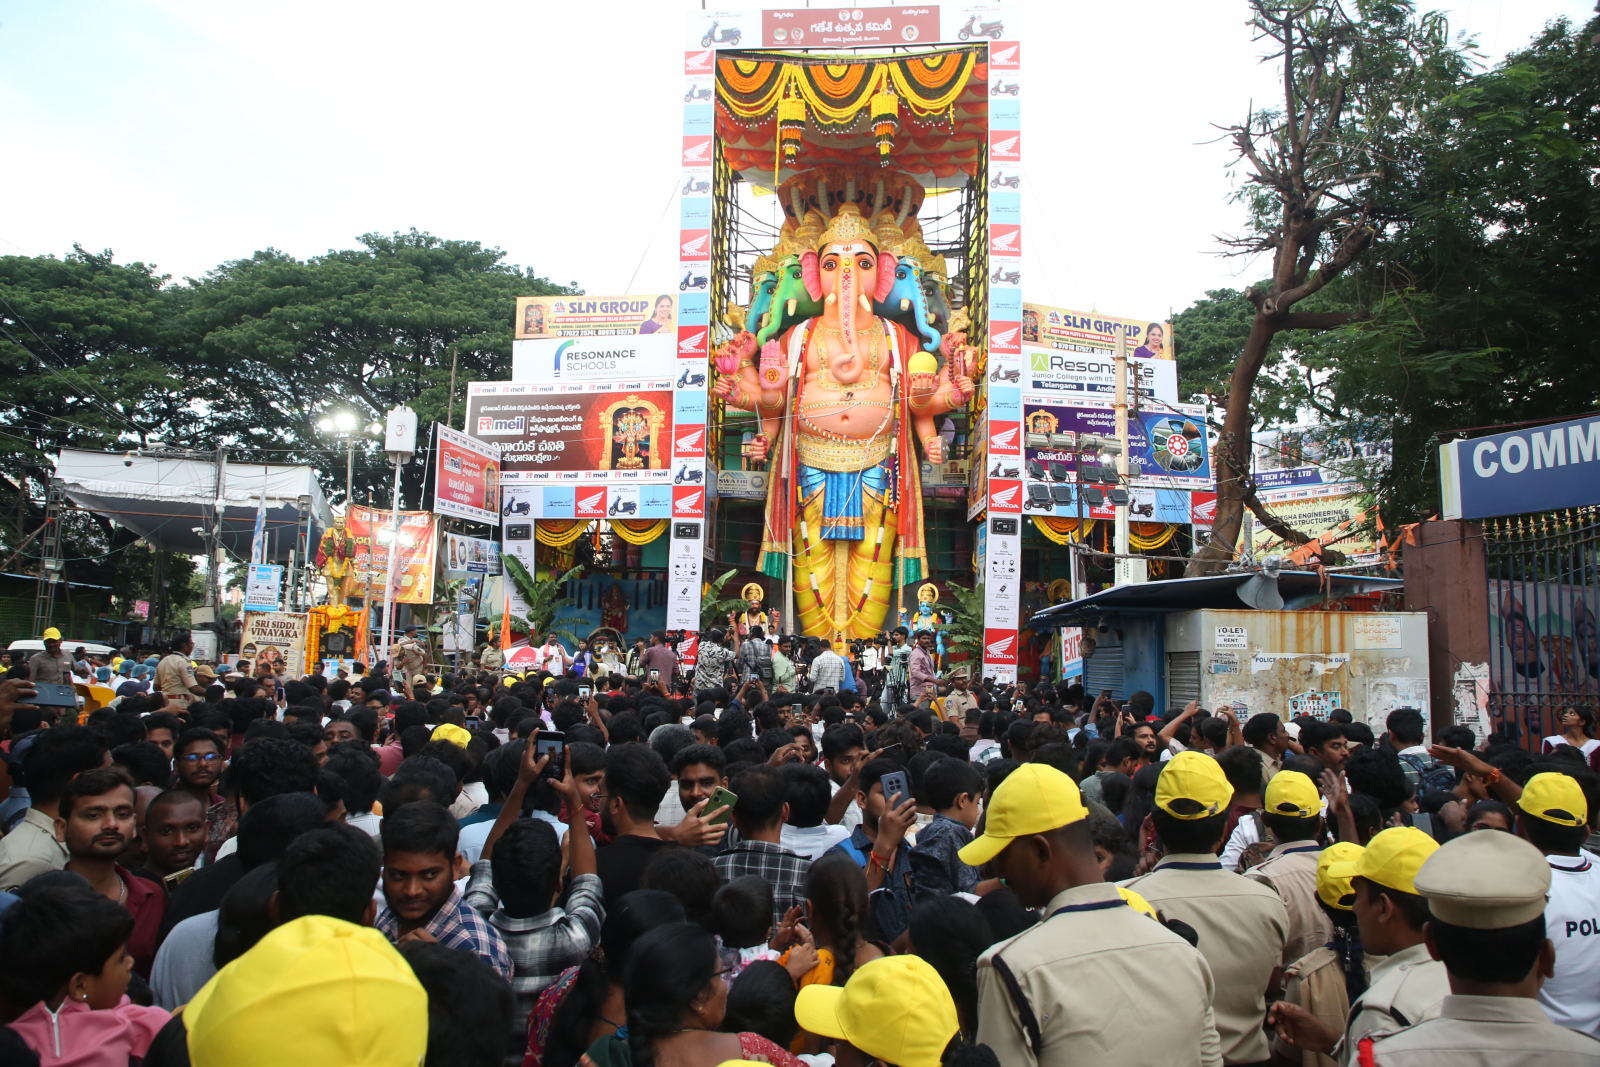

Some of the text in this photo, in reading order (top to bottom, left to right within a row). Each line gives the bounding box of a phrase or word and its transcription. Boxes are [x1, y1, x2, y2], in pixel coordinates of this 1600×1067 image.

[569, 300, 649, 314] SLN GROUP
[1064, 315, 1091, 330] SLN
[566, 350, 636, 361] RESONANCE
[566, 361, 616, 371] SCHOOLS
[1056, 373, 1086, 382] Colleges
[1088, 374, 1102, 382] with
[1041, 381, 1077, 391] Telangana
[494, 416, 524, 430] meil
[538, 440, 565, 452] చవితి
[1473, 421, 1600, 478] COMM
[1262, 472, 1278, 480] TECH
[1298, 470, 1312, 478] LTD
[1298, 510, 1343, 518] ENGINEERING
[254, 620, 296, 630] SRI SIDDI
[251, 627, 298, 638] VINAYAKA
[1064, 634, 1082, 662] EXIT
[1566, 918, 1600, 938] POL
